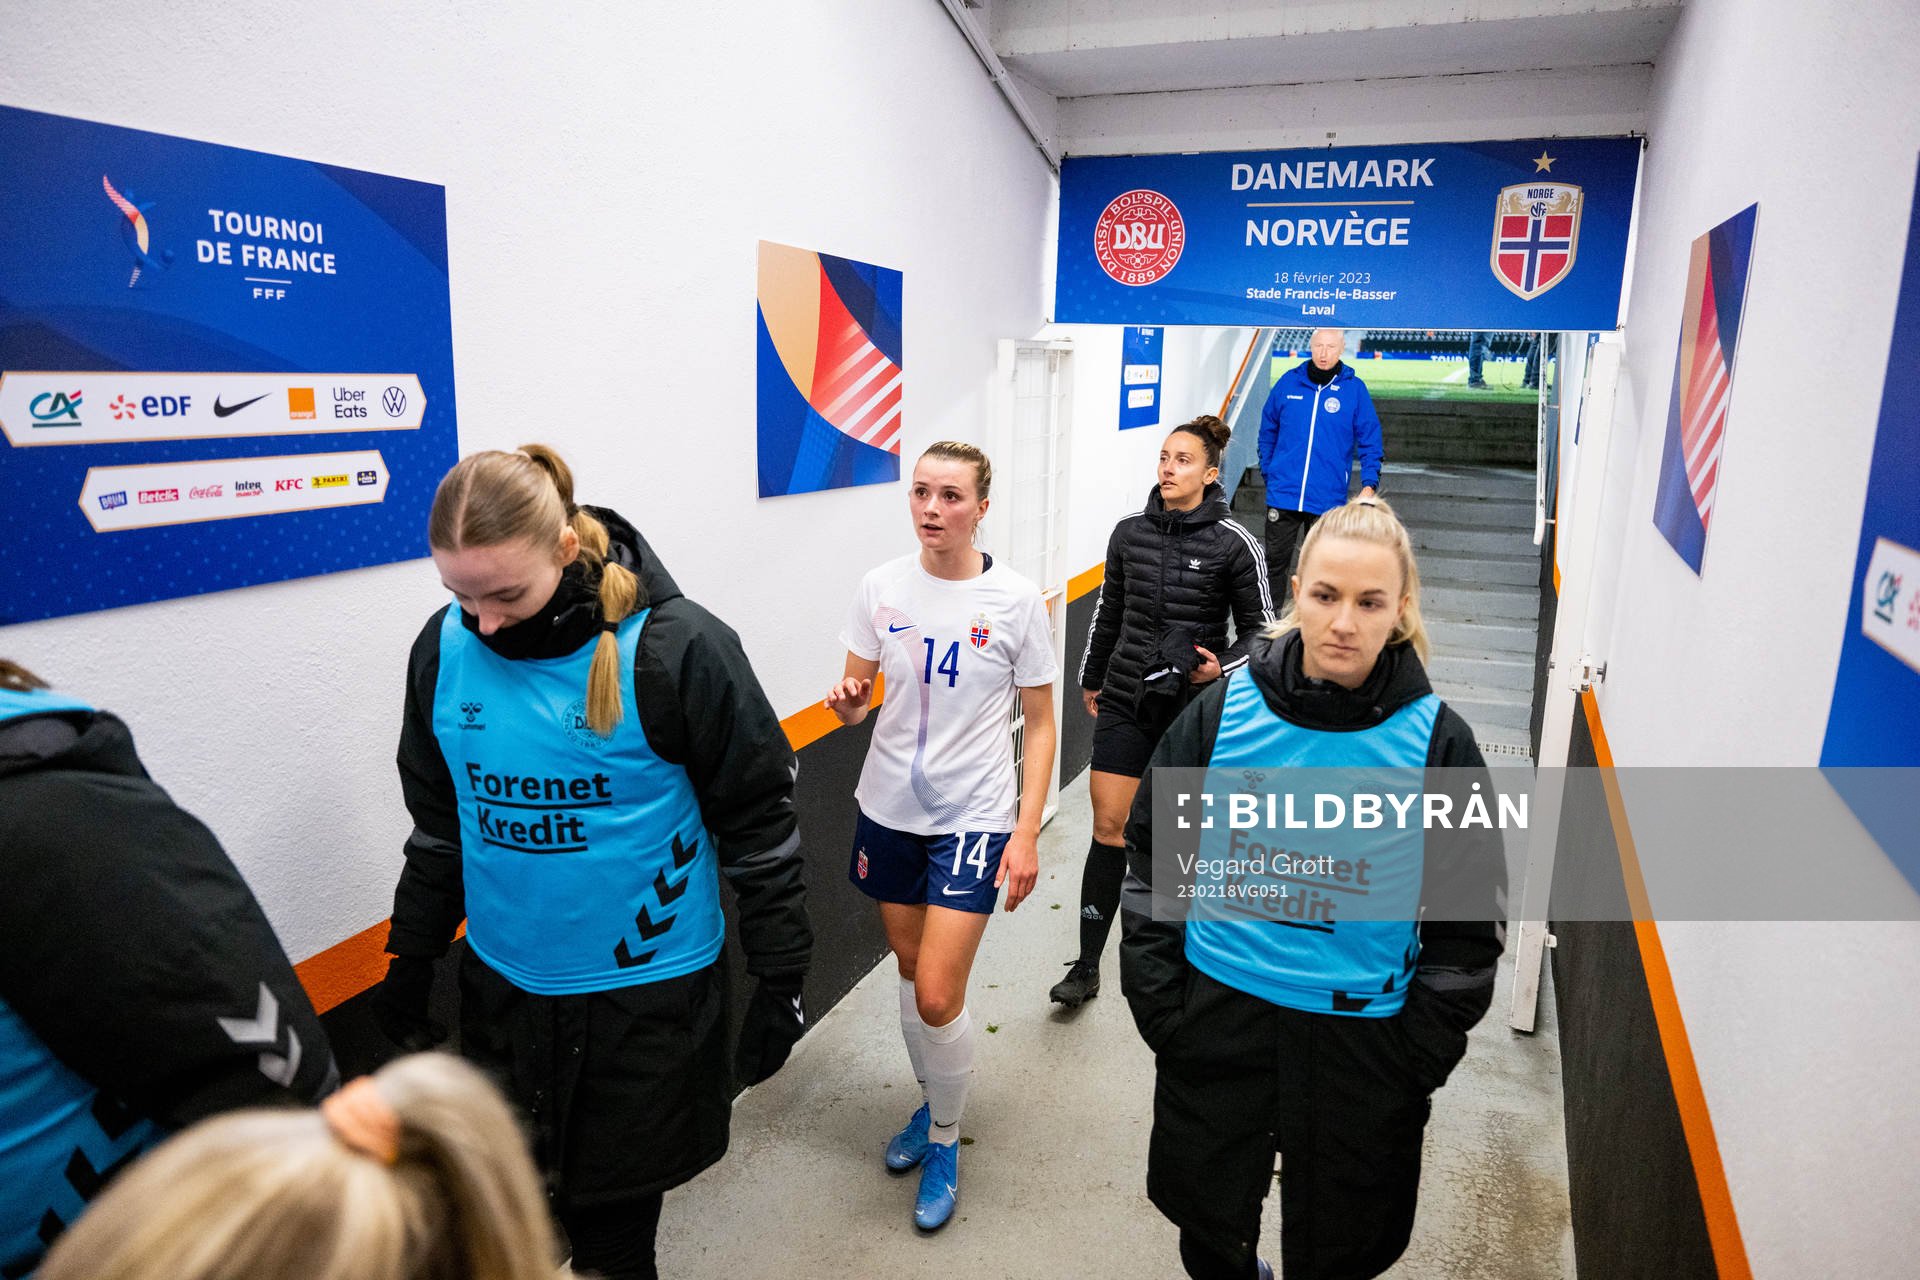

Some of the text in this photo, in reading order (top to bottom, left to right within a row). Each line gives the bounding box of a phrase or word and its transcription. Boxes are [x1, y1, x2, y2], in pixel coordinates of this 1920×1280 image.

[1231, 158, 1436, 190] DANEMARK
[1527, 188, 1554, 199] NORGE
[208, 209, 323, 244] TOURNOI
[1112, 222, 1165, 251] DBU
[1245, 210, 1411, 247] NORVÈGE
[1097, 217, 1118, 273] DANSK
[196, 239, 336, 274] DE FRANCE
[1119, 270, 1156, 283] 1889
[1274, 271, 1371, 284] 18 février 2023
[253, 287, 286, 300] FFF
[1246, 288, 1397, 300] Stade Francis-le-Basser
[1301, 304, 1335, 316] Laval
[333, 387, 366, 401] Uber
[334, 404, 367, 418] Eats
[140, 489, 178, 503] Betclic
[275, 479, 303, 492] KFC
[923, 637, 959, 688] 14
[465, 762, 611, 800] Forenet
[477, 805, 588, 846] Kredit
[952, 832, 990, 880] 14
